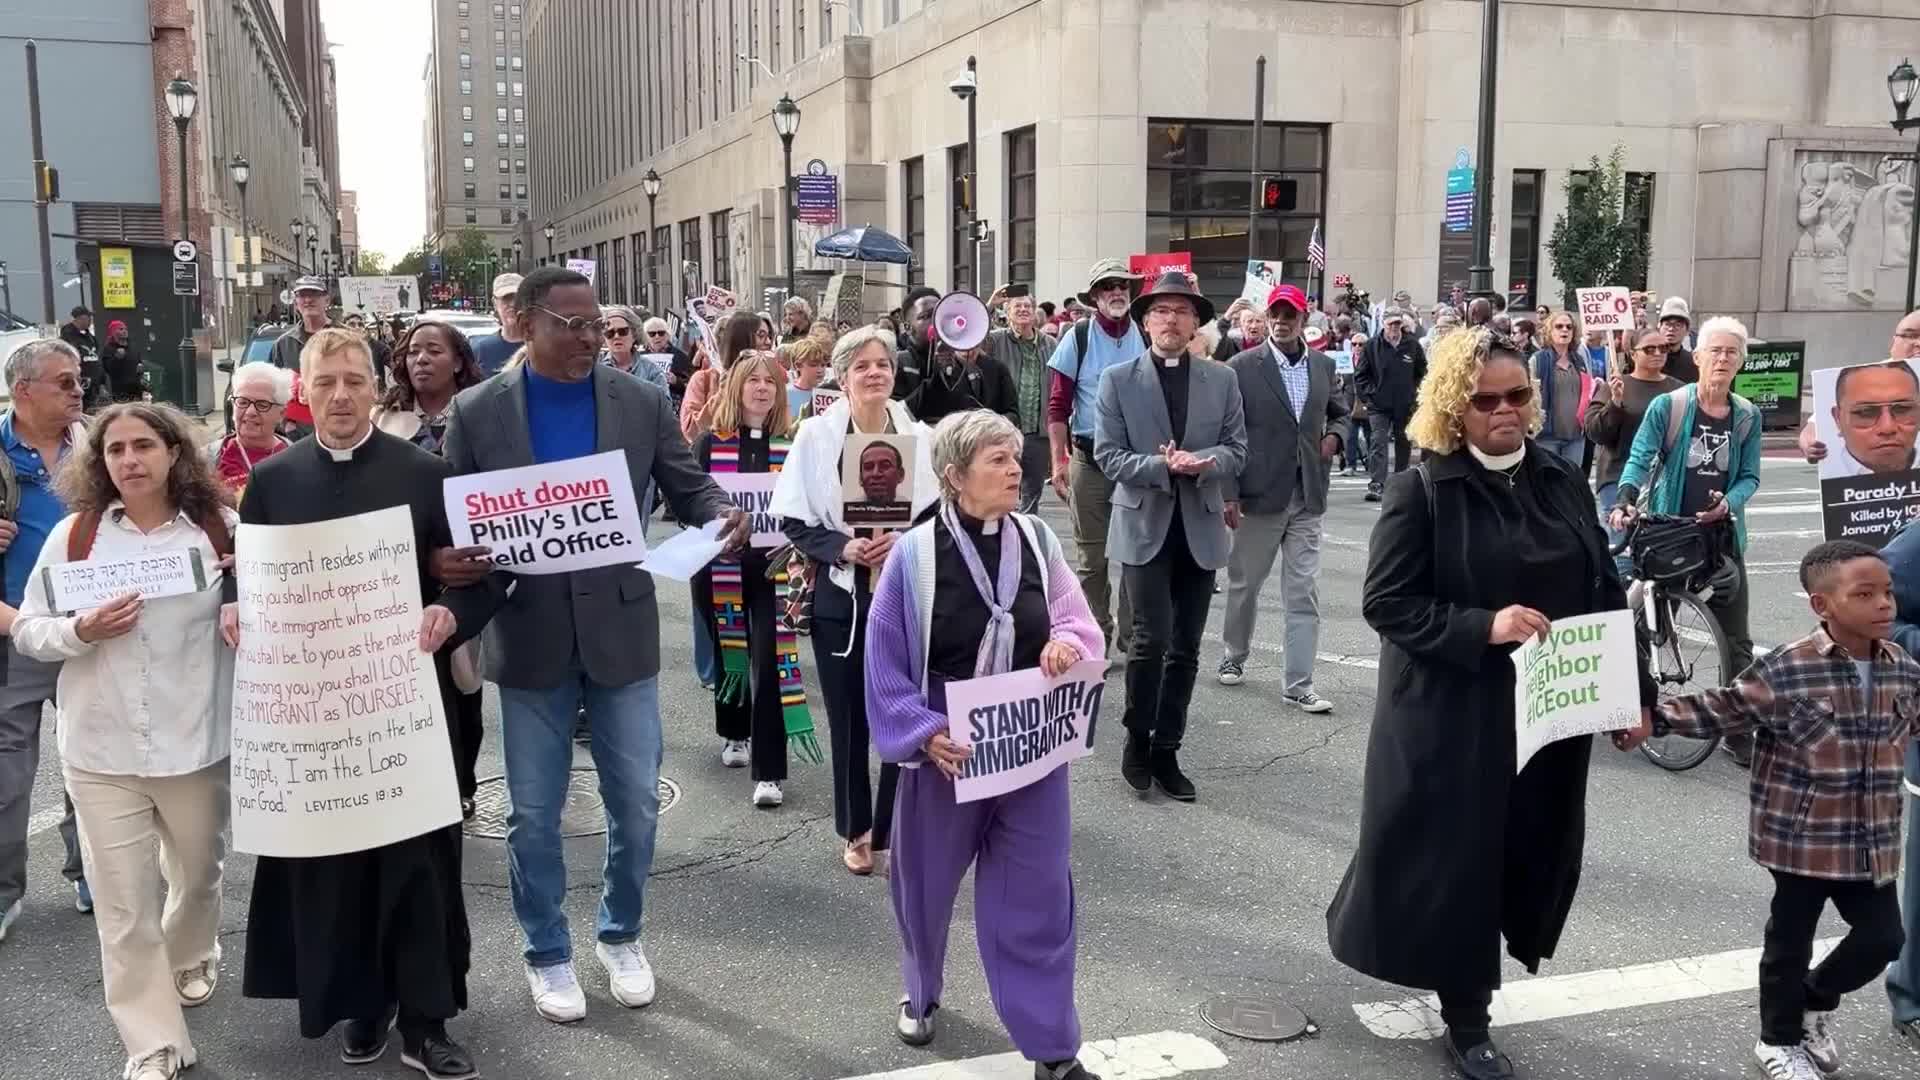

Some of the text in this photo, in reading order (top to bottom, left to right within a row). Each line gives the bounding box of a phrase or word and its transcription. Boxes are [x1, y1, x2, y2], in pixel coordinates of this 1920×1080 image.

[1582, 291, 1612, 302] STOP
[1583, 303, 1602, 314] ICE
[1584, 314, 1619, 325] RAIDS
[465, 477, 610, 516] Shut down
[1844, 482, 1907, 501] Parady
[470, 499, 618, 545] Philly's ICE
[1841, 523, 1891, 536] January
[1850, 507, 1884, 522] Killed
[1886, 507, 1903, 521] by
[321, 544, 364, 572] resides
[369, 538, 391, 563] with
[390, 540, 411, 565] you
[542, 530, 632, 559] Office.
[64, 582, 96, 594] LOVE
[96, 577, 129, 591] YOUR
[265, 591, 281, 611] you
[283, 584, 311, 604] shall
[313, 579, 336, 602] not
[337, 577, 379, 602] oppress
[381, 567, 401, 588] the
[258, 611, 281, 633] The
[281, 607, 344, 639] immigrant
[346, 602, 372, 626] who
[374, 591, 409, 621] resides
[257, 644, 279, 664] shall
[282, 643, 300, 664] be
[302, 641, 318, 664] to
[320, 650, 345, 670] you
[348, 646, 362, 658] as
[364, 631, 385, 651] the
[1549, 623, 1607, 655] your
[318, 680, 341, 700] you
[344, 661, 377, 691] shall
[381, 648, 421, 681] LOVE
[1526, 653, 1602, 698] neighbor
[323, 709, 340, 722] as
[968, 680, 1086, 742] STAND WITH
[1526, 681, 1600, 728] #ICEout
[260, 741, 289, 754] were
[291, 727, 363, 760] immigrants
[368, 730, 382, 745] in
[387, 719, 406, 737] the
[409, 704, 434, 733] land
[286, 757, 301, 784] I
[305, 768, 328, 784] am
[333, 753, 364, 780] the
[236, 796, 257, 817] your
[305, 793, 369, 813] LEVITICUS
